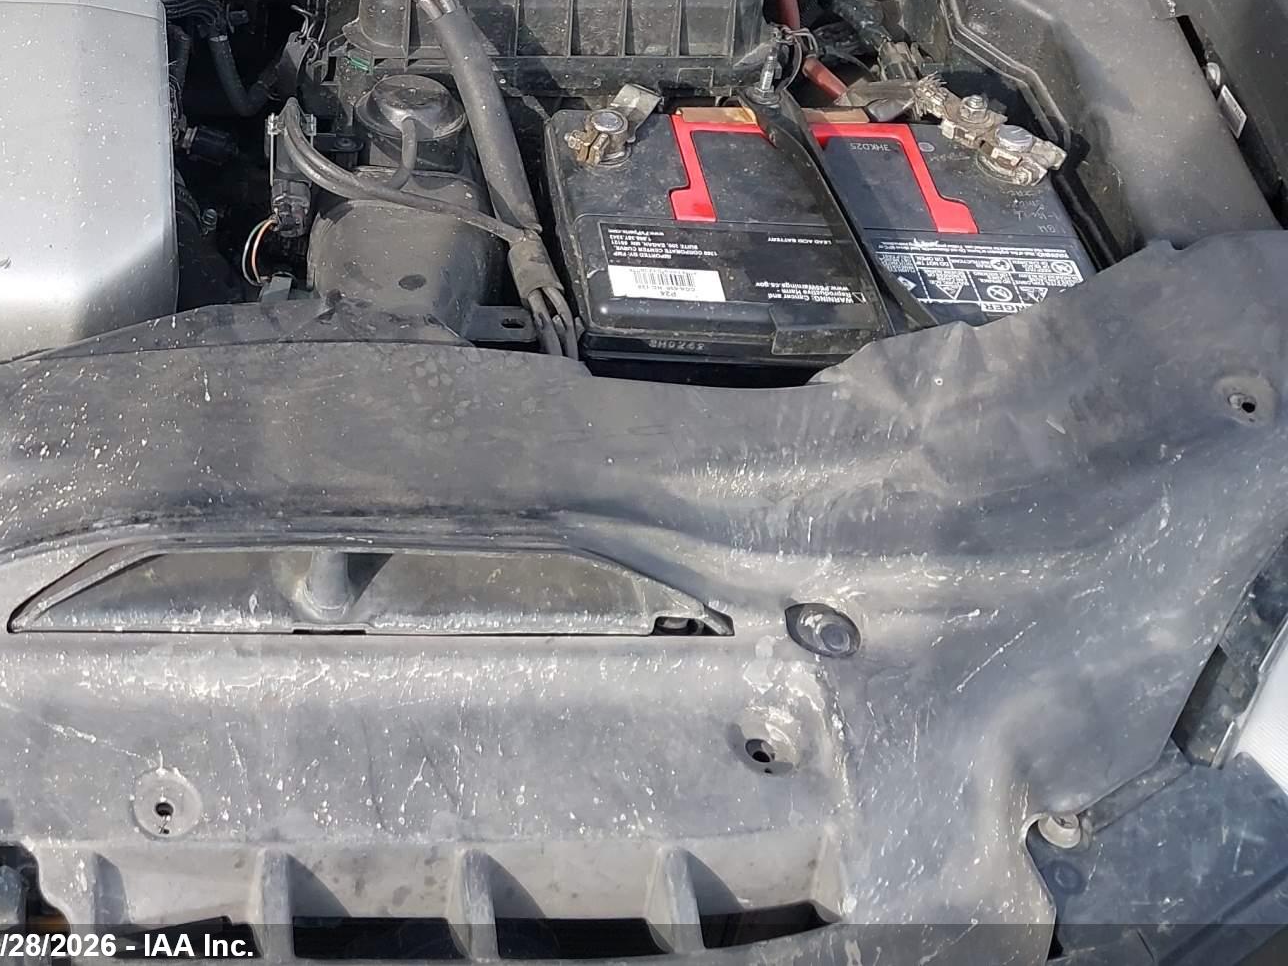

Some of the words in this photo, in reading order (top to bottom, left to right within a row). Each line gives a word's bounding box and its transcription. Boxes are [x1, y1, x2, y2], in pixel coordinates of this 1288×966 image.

[664, 247, 703, 256] CORPORATE
[781, 287, 802, 295] Harm
[802, 289, 852, 298] Reproductive
[783, 293, 810, 301] Cancer
[810, 295, 855, 304] WARNING:
